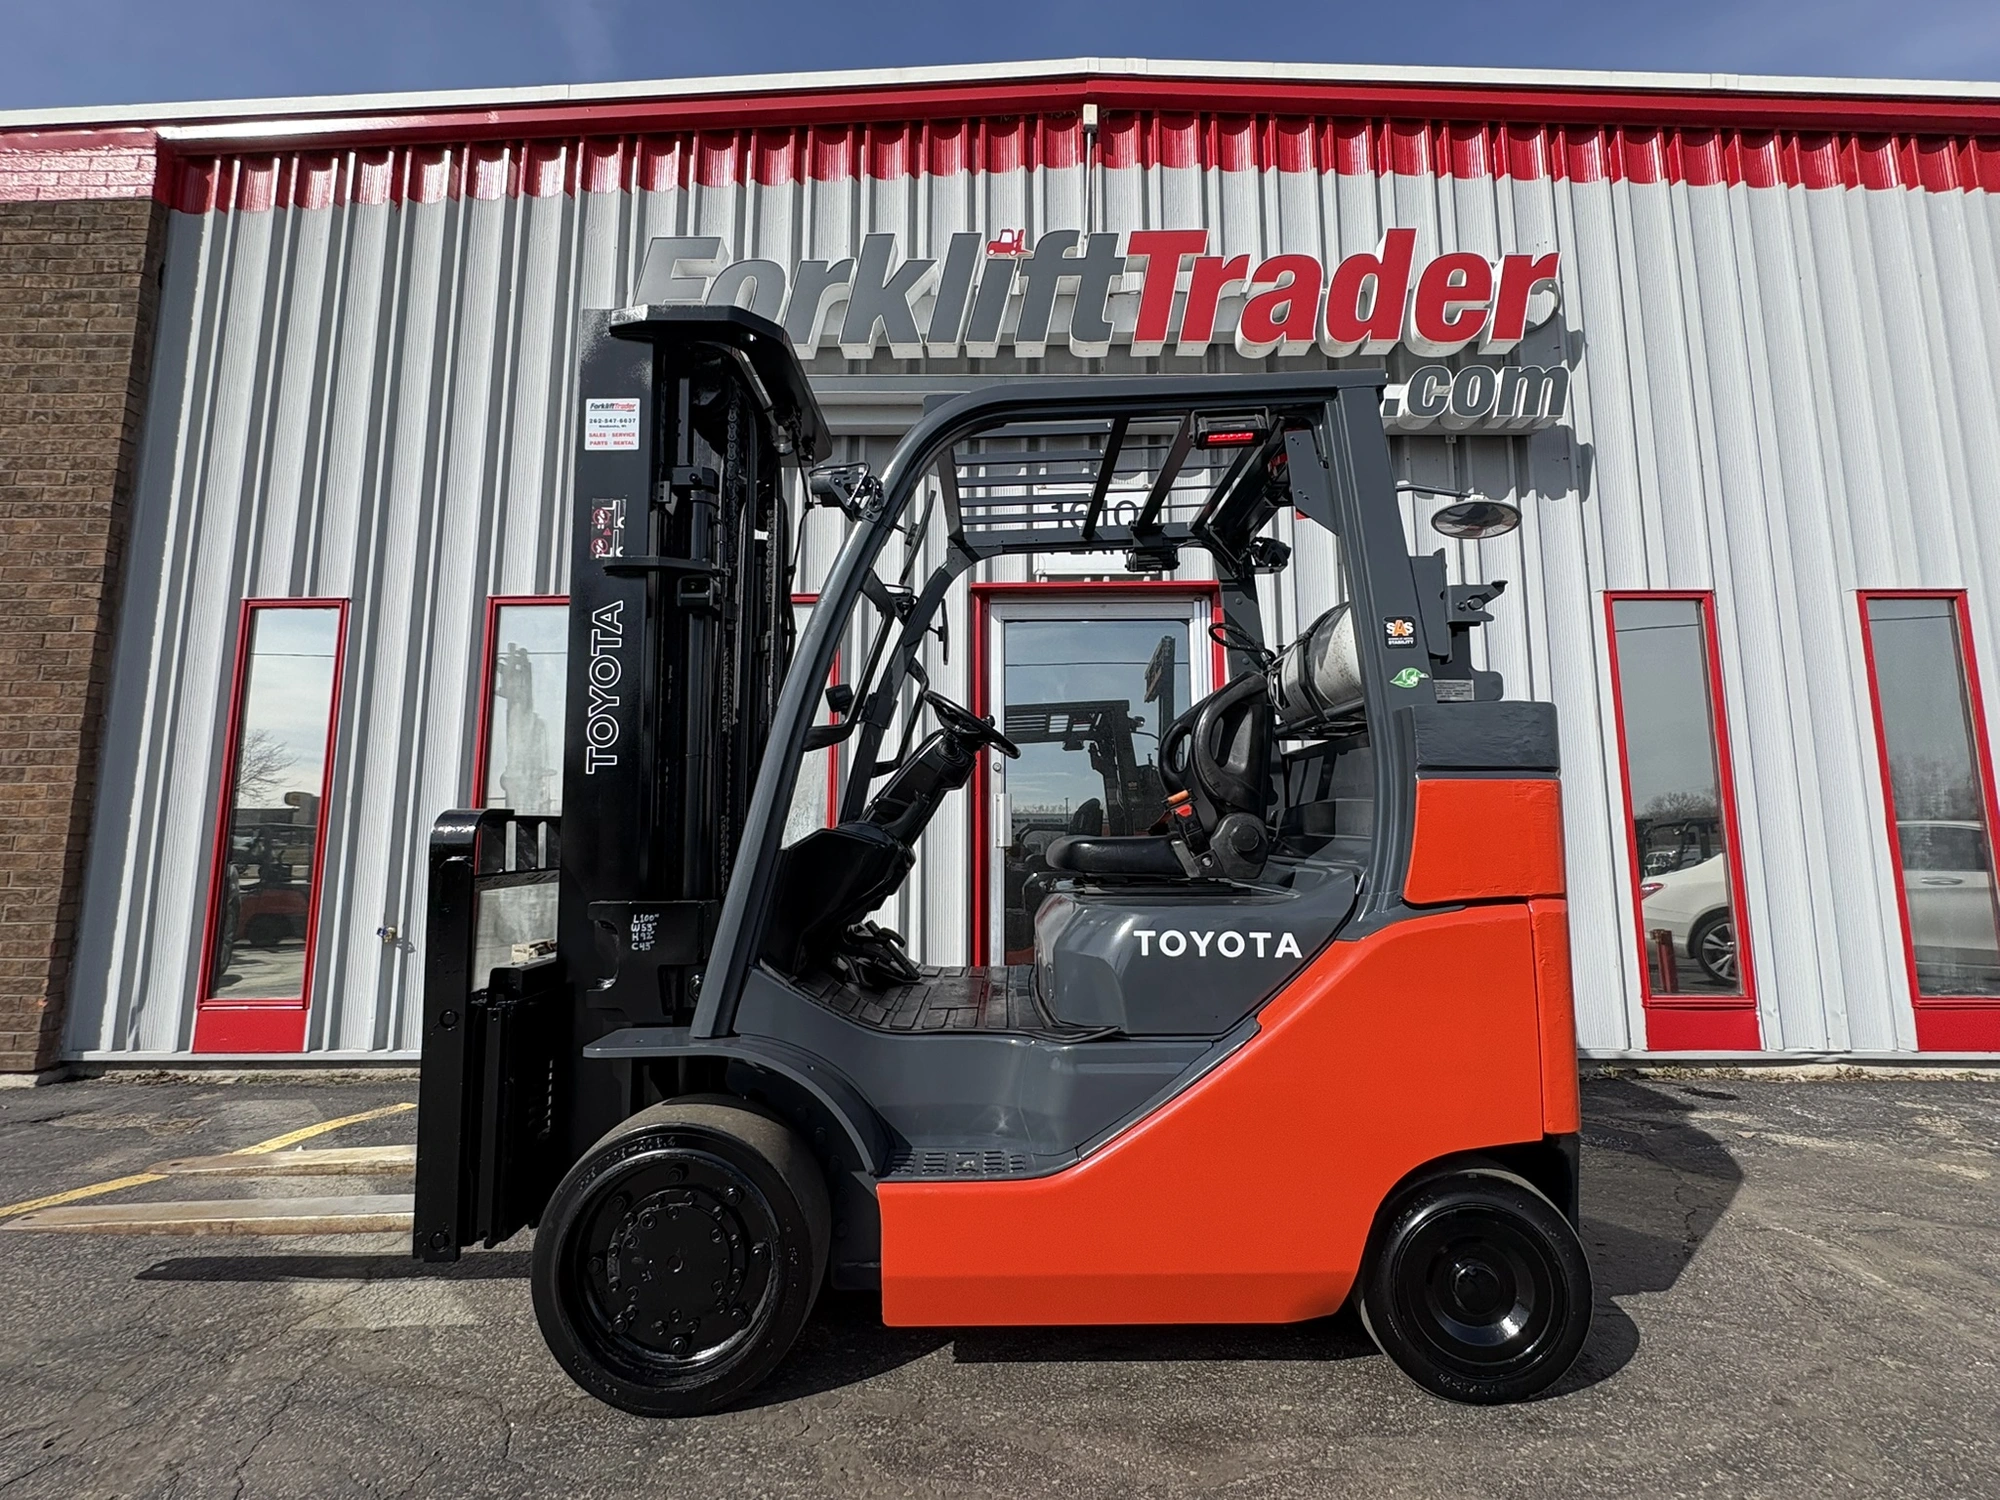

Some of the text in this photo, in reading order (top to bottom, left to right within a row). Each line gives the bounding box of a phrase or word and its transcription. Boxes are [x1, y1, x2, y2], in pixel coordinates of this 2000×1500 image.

[632, 226, 1562, 352] ForkliftTrader
[1382, 364, 1571, 418] .com
[1386, 619, 1414, 637] SAS
[585, 600, 624, 775] TOYOTA
[1133, 929, 1303, 959] TOYOTA
